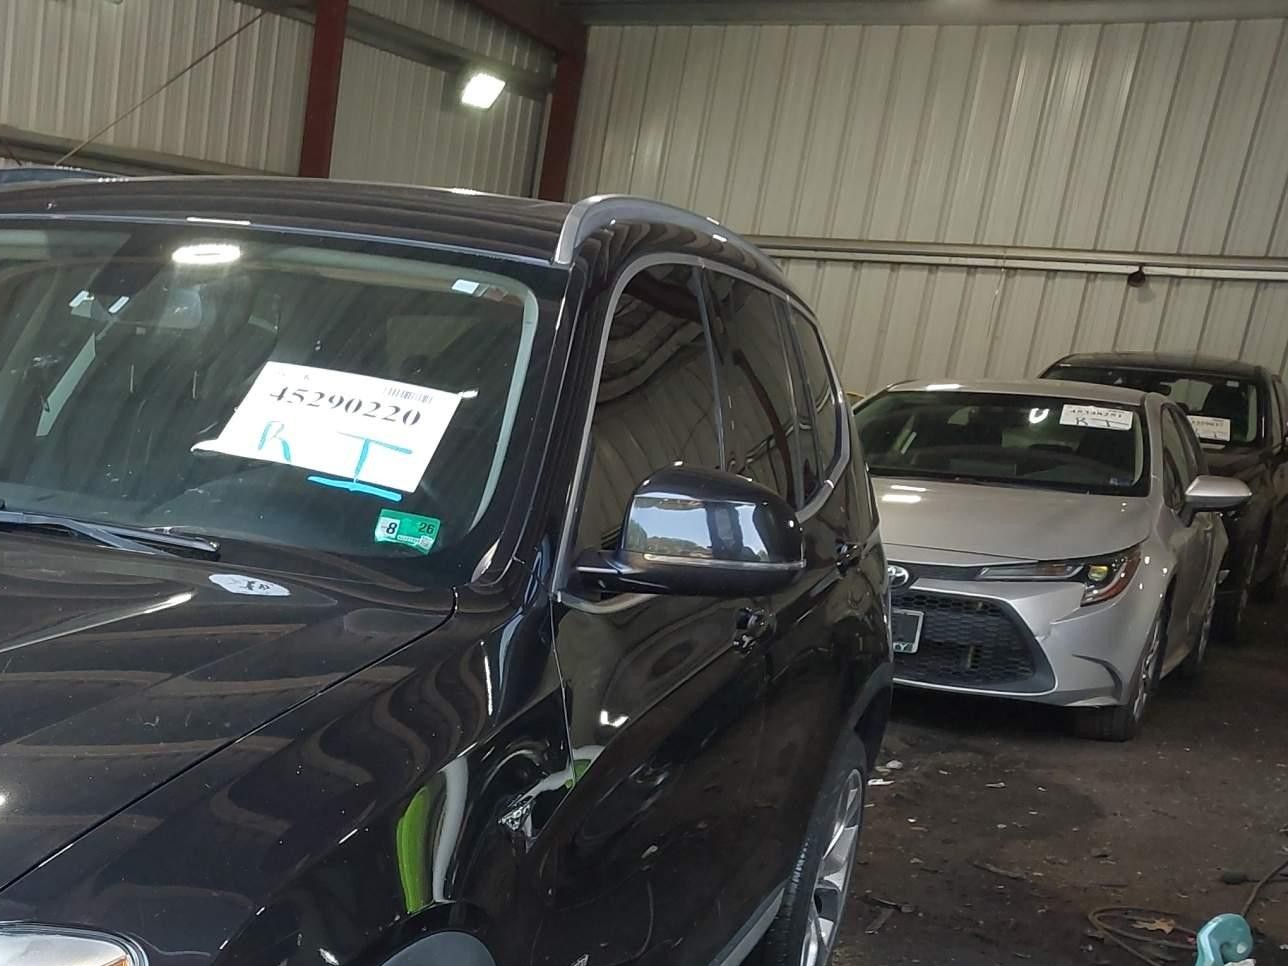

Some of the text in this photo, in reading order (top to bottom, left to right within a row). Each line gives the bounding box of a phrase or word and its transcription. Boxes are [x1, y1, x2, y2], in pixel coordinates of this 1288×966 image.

[269, 385, 422, 426] 45290220
[385, 522, 398, 535] 8
[418, 522, 435, 535] 26
